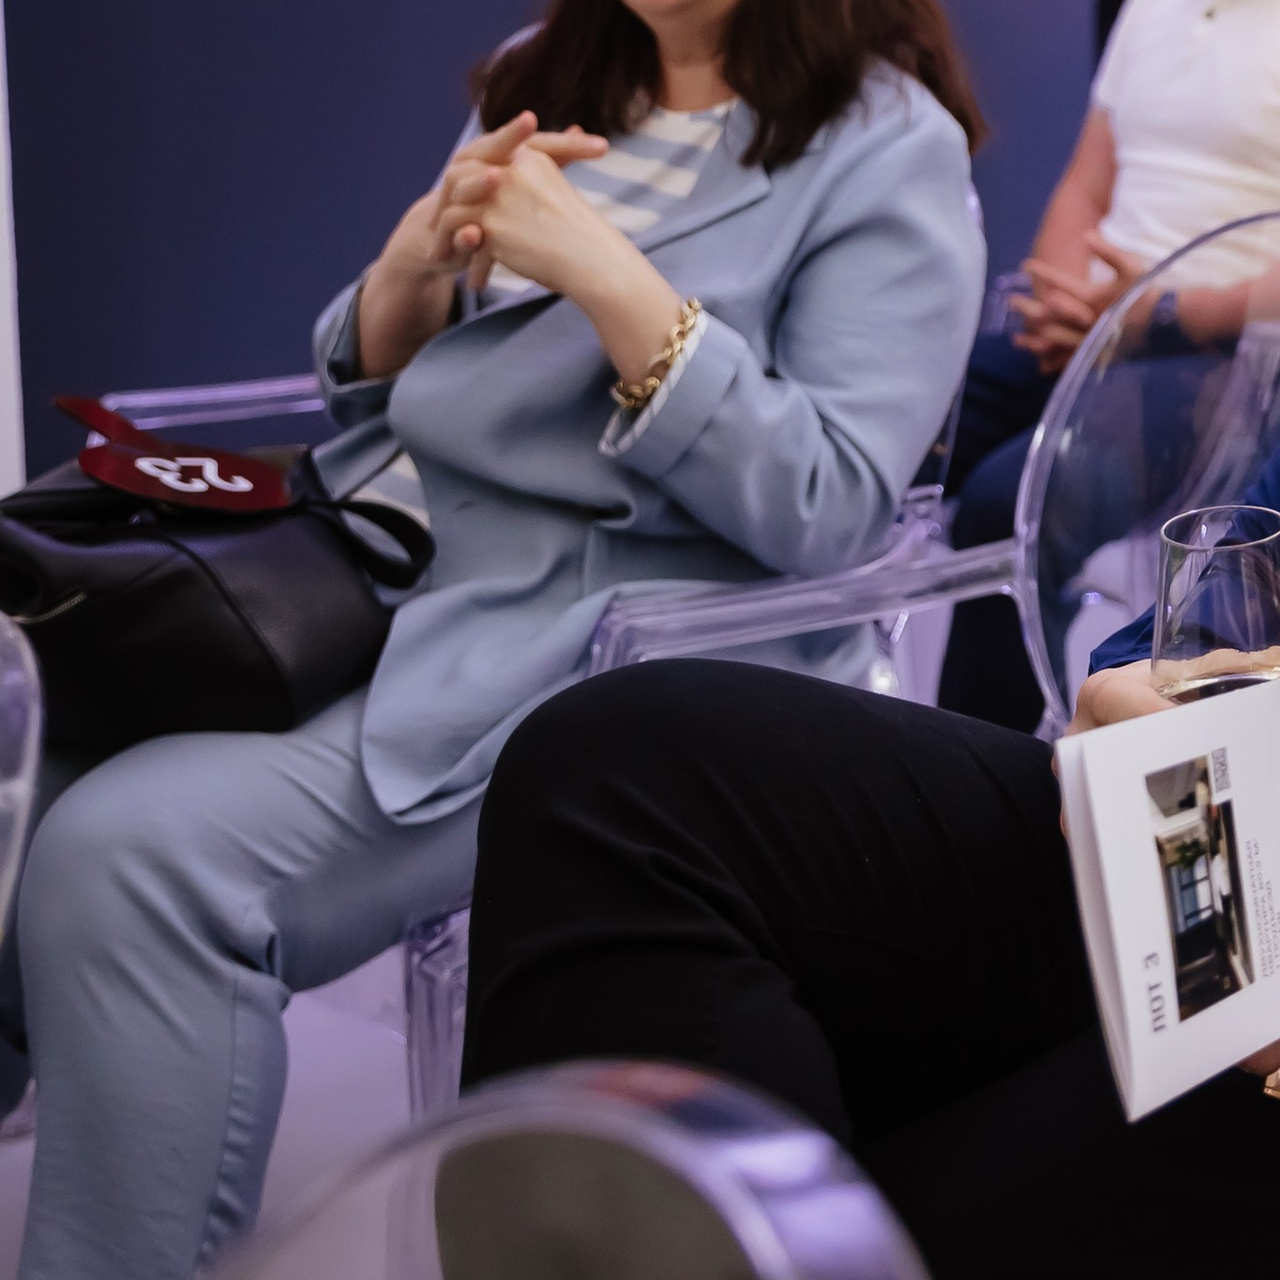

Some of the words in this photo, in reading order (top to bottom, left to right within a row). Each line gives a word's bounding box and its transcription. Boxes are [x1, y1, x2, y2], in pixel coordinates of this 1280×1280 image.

[134, 457, 254, 493] 23
[1144, 951, 1160, 970] 3
[1147, 981, 1167, 1033] ЛОТ
